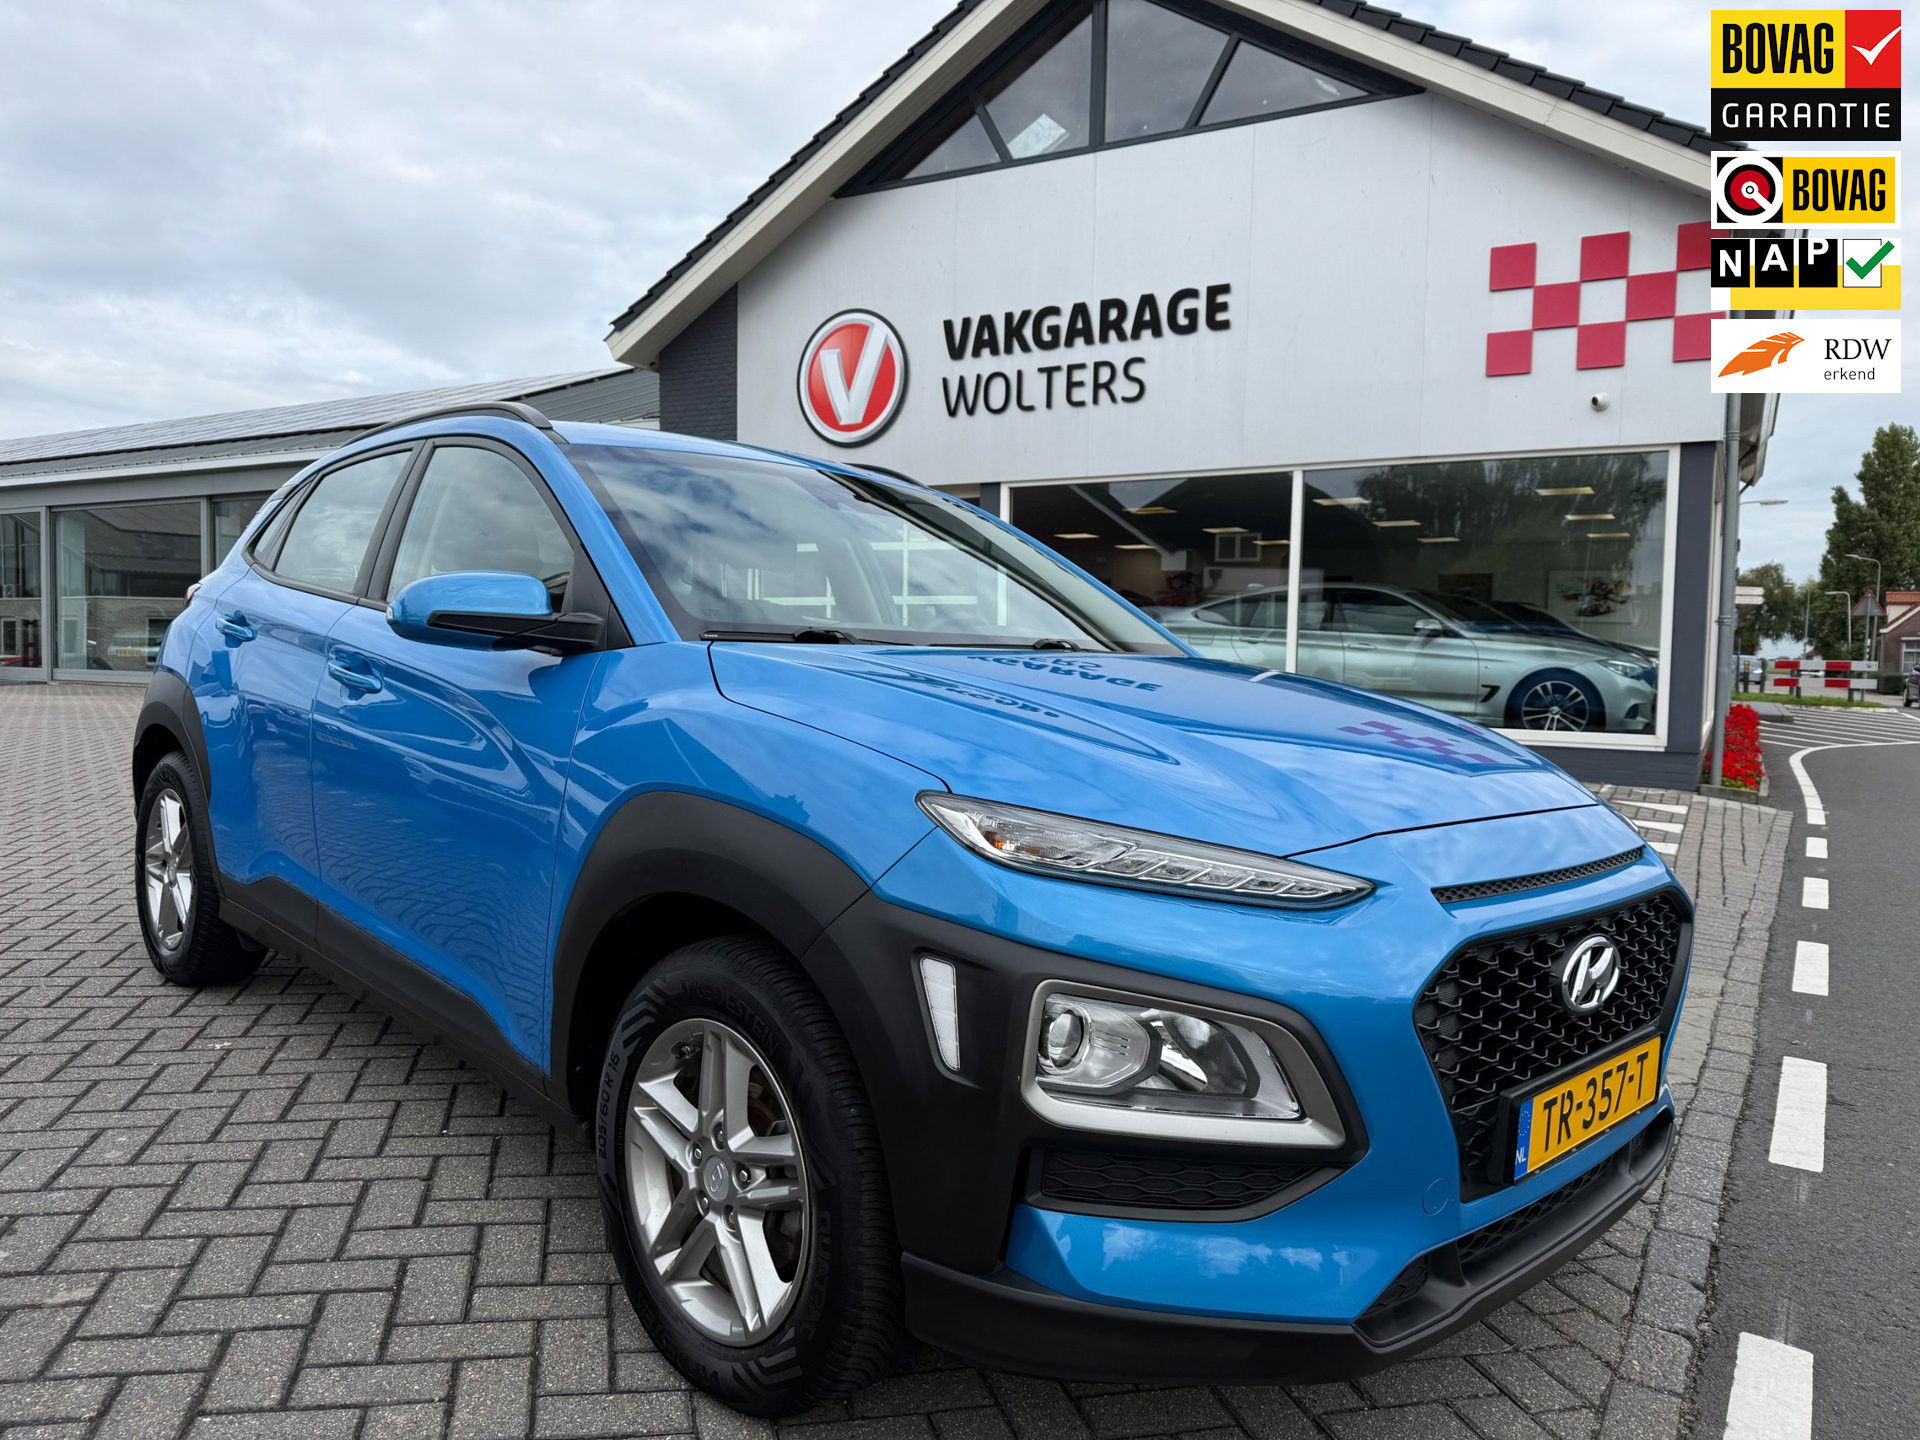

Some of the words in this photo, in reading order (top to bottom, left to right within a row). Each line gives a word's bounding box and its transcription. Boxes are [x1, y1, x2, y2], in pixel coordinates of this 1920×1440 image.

[943, 283, 1231, 360] VAKGARAGE
[942, 357, 1146, 418] WOLTERS
[604, 1072, 614, 1088] R
[608, 1050, 619, 1071] 16
[599, 1089, 610, 1160] 205/60
[1543, 1051, 1649, 1152] TR-357-T
[1515, 1147, 1527, 1165] NL
